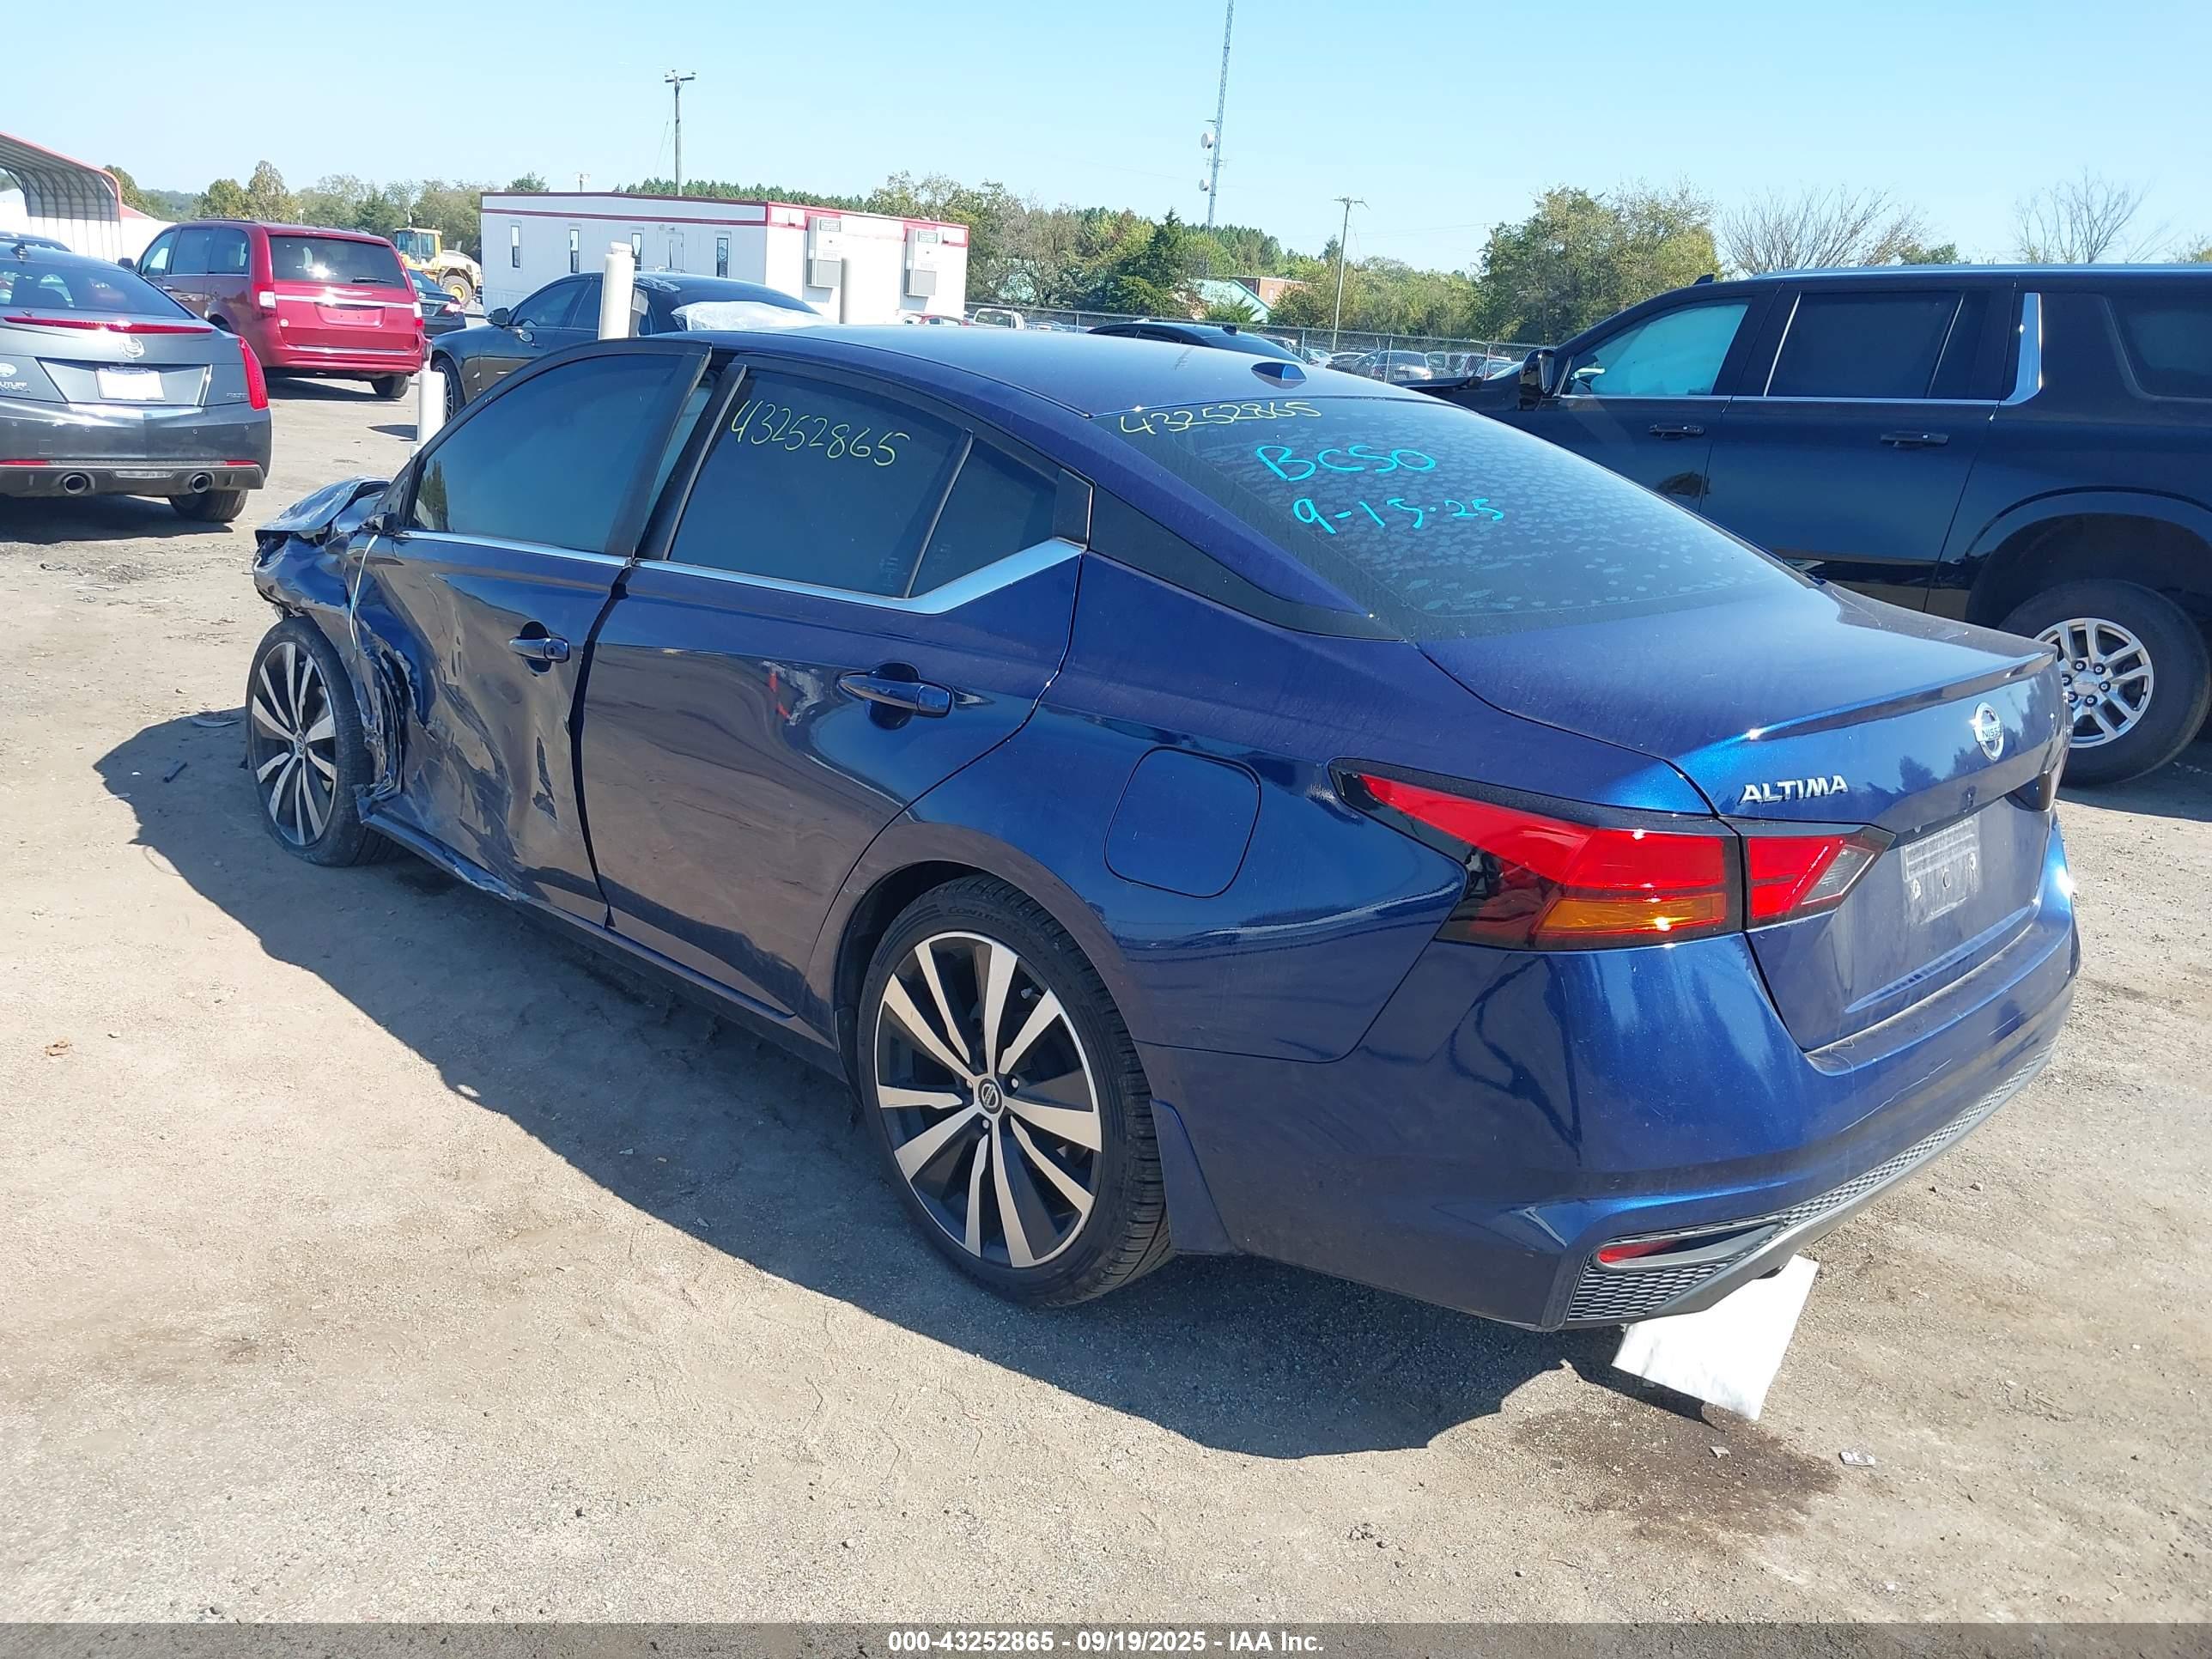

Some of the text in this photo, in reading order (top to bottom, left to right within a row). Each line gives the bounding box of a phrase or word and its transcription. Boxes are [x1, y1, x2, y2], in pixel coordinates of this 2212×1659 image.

[732, 399, 910, 466] 43252865
[1120, 401, 1322, 435] 43252865
[1256, 445, 1436, 481] BCSO
[1738, 775, 1849, 805] ALTIMA
